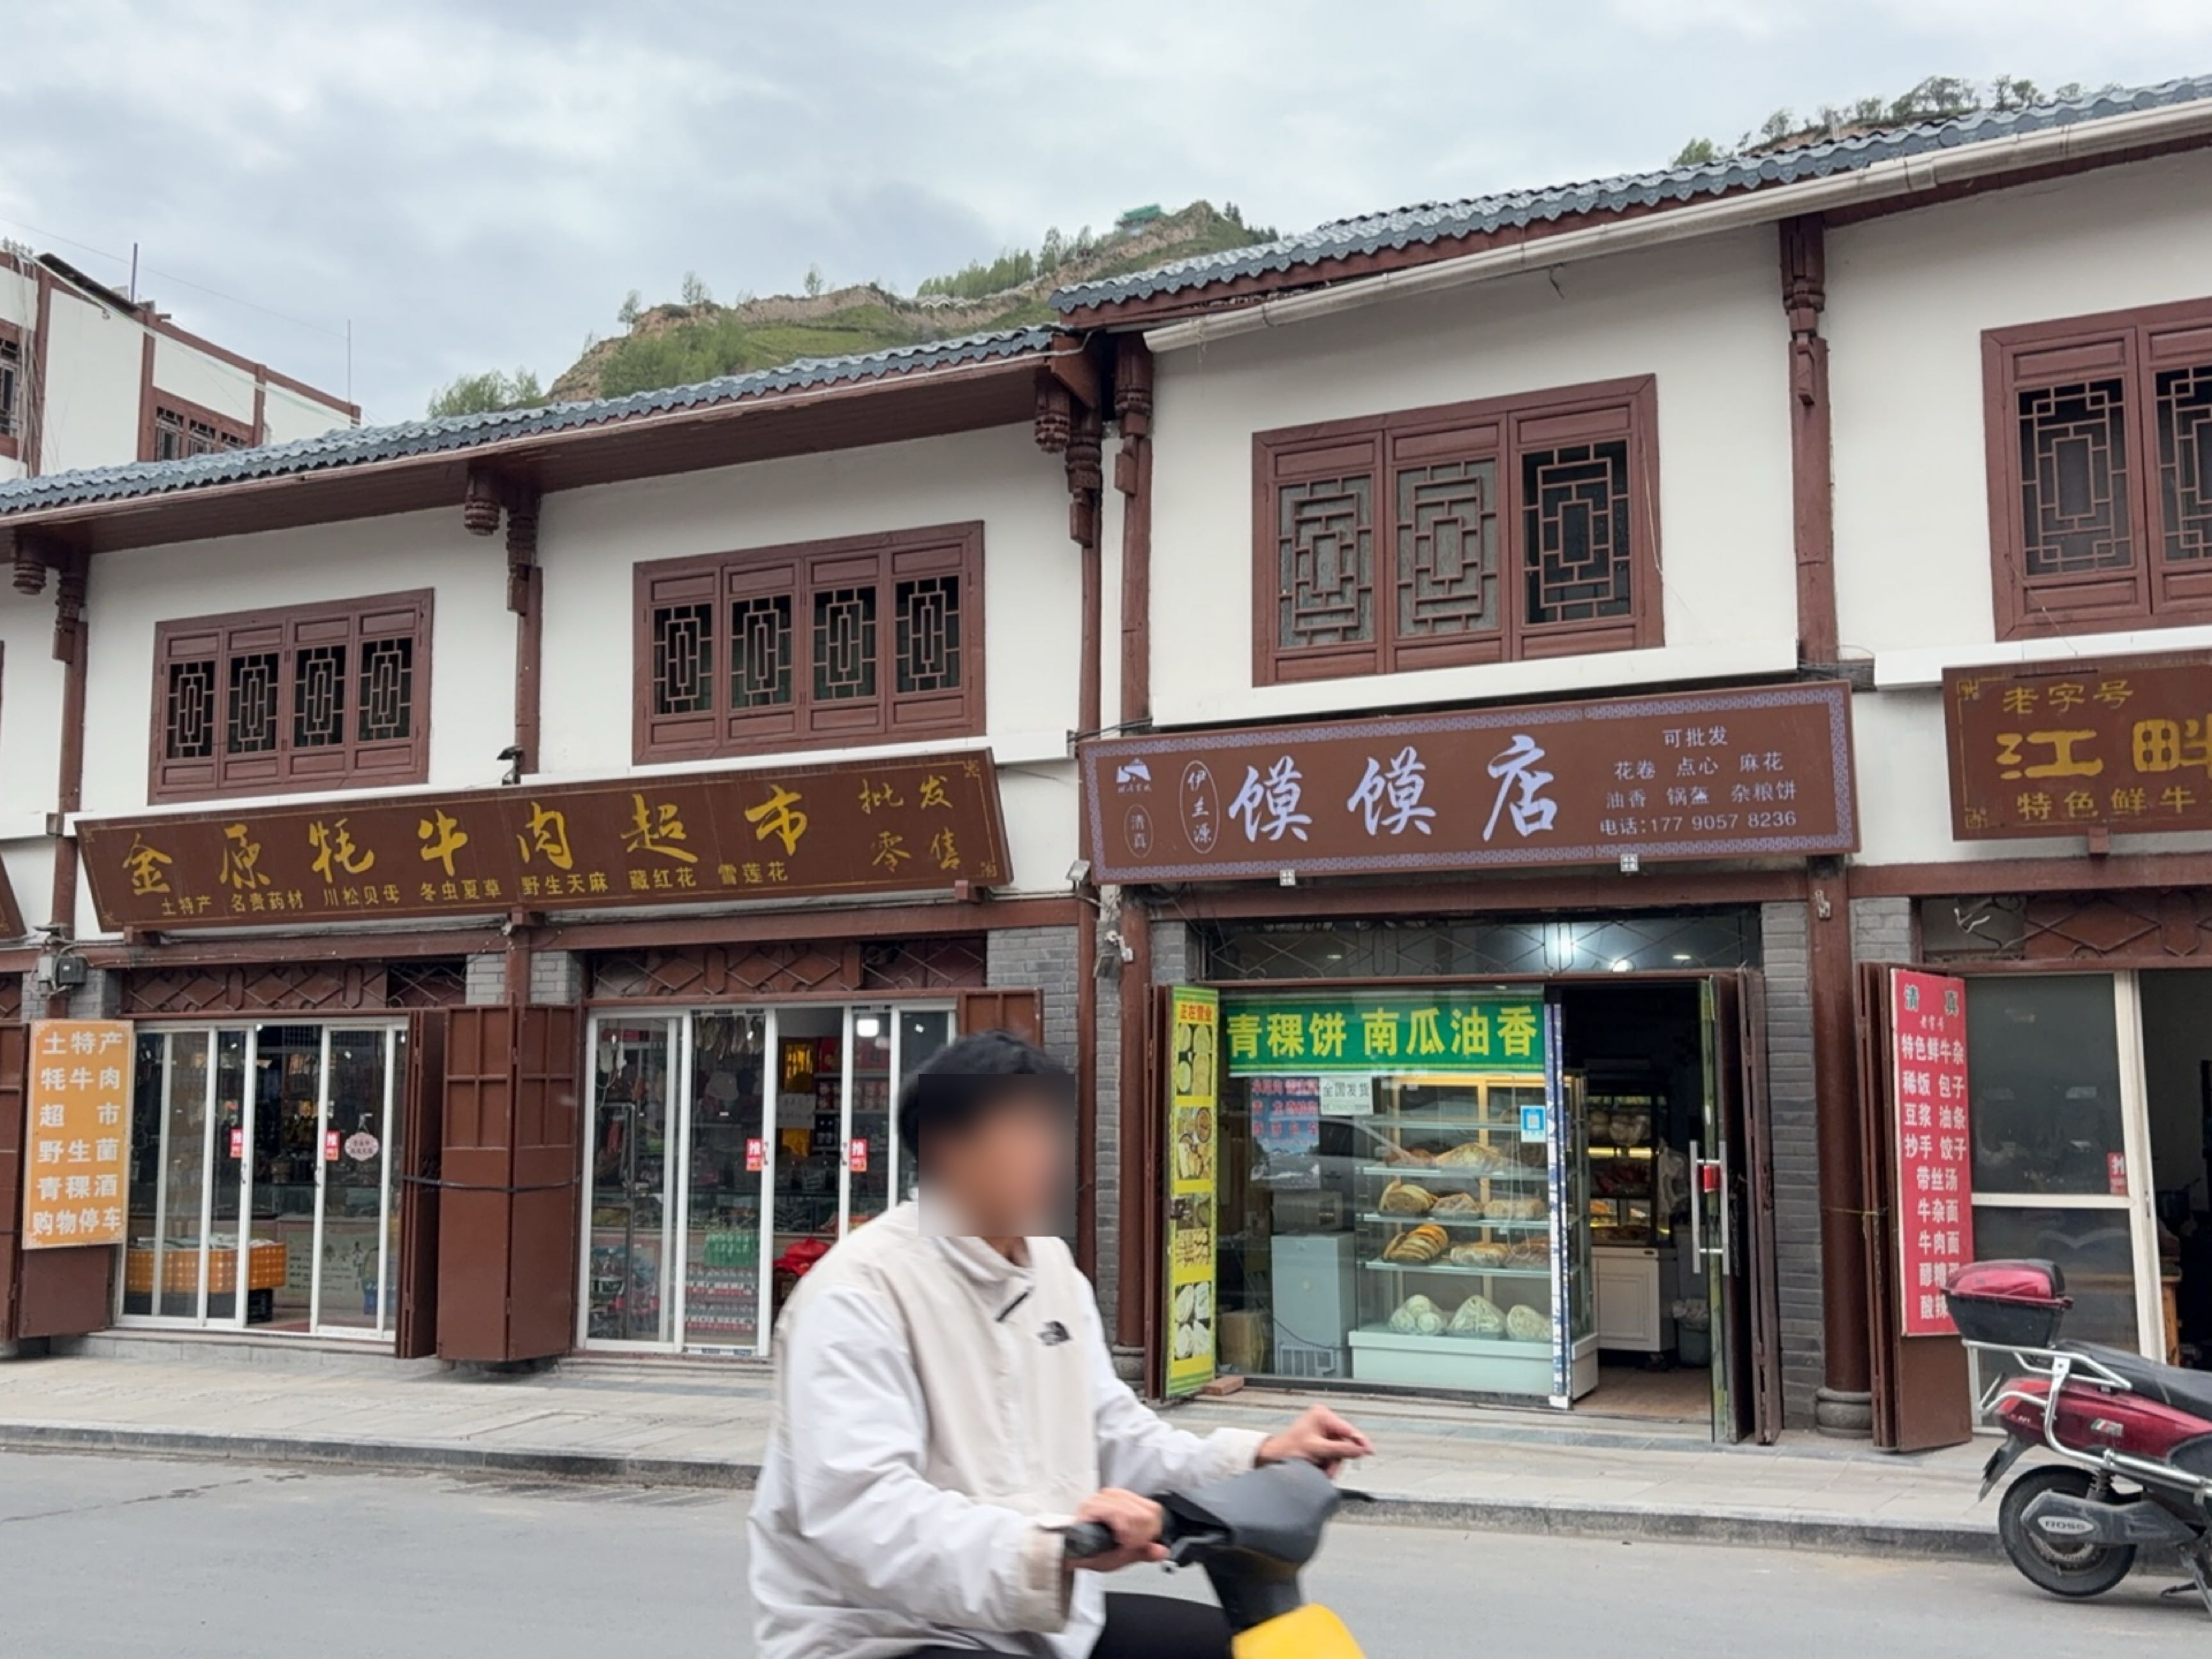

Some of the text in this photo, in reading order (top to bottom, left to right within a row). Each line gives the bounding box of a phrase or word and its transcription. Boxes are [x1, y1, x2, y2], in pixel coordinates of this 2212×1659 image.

[2002, 679, 2134, 714] 老字号
[1662, 725, 1728, 748] 可批发
[1614, 751, 1784, 781] 花卷 点心 麻花
[858, 774, 952, 814] 批发
[1228, 733, 1558, 843] 馍馍店
[1606, 780, 1797, 810] 油香 锅盔 杂粮饼
[2017, 785, 2212, 821] 特色鲜牛
[1691, 814, 1738, 831] 9057
[1747, 812, 1797, 828] 8236
[161, 860, 788, 915] 土特产 名贵药材 川松贝母 冬虫夏草 野生天麻 藏红花 雪莲花
[1903, 983, 1959, 1016] 清真
[42, 1030, 123, 1055] 土特产
[1227, 1006, 1537, 1058] 青稞饼 南瓜油香
[1902, 1033, 1964, 1065] 特色鲜牛杂
[40, 1066, 121, 1091] 牦牛肉
[1903, 1070, 1964, 1099] 稀饭 包子
[39, 1102, 121, 1127] 超市
[1903, 1103, 1966, 1130] 豆浆 油条
[37, 1138, 119, 1164] 野生菌
[1904, 1133, 1967, 1161] 抄手 饺子
[37, 1174, 118, 1201] 青稞酒
[32, 1206, 122, 1236] 购物停车
[1917, 1198, 1959, 1224] 牛杂面
[1918, 1230, 1960, 1256] 牛肉面
